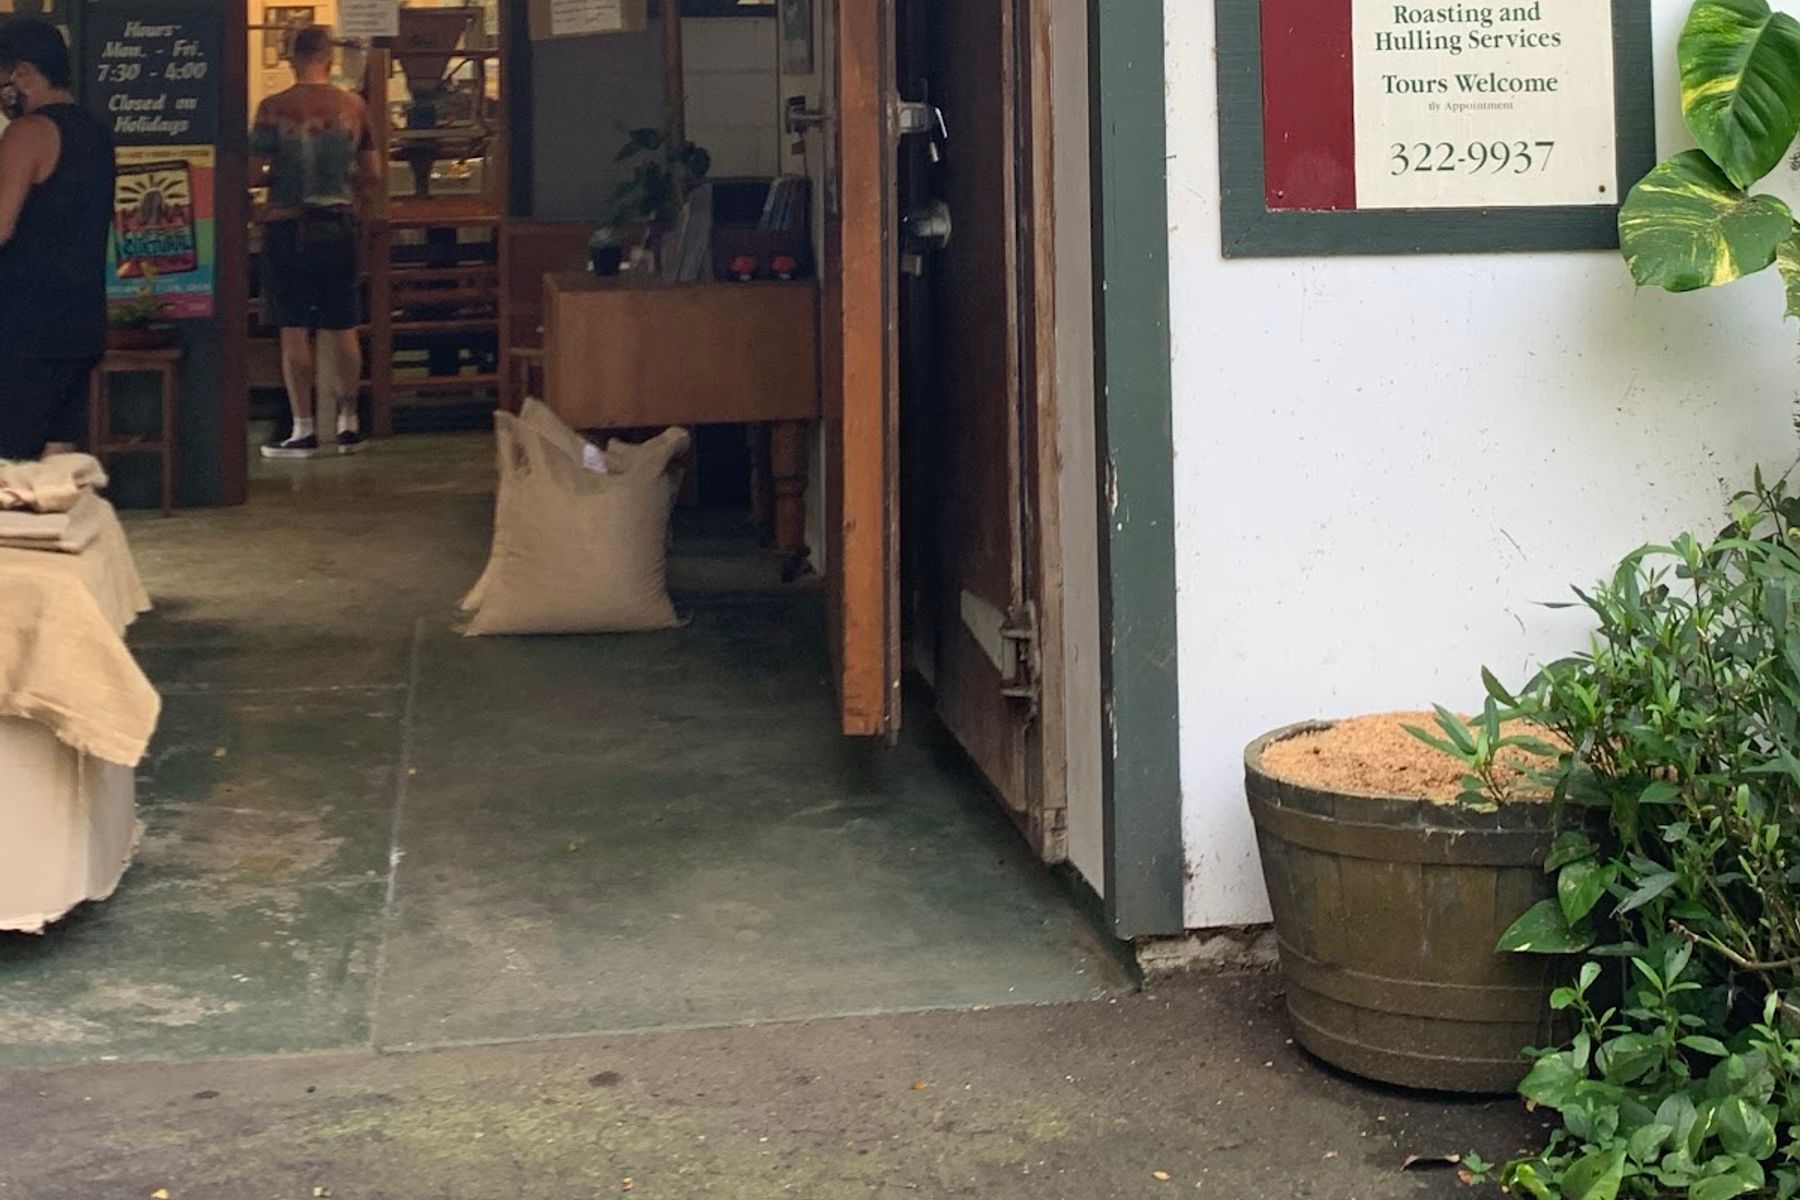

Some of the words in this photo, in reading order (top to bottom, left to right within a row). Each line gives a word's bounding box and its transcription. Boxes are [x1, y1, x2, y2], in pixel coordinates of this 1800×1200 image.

[1393, 4, 1493, 27] Roasting
[1499, 1, 1541, 22] and
[124, 21, 182, 37] Hours
[1374, 31, 1462, 55] Hulling
[1468, 29, 1561, 50] Services
[97, 63, 141, 82] 7:30
[1382, 74, 1448, 94] Tours
[1455, 72, 1558, 93] Welcome
[108, 94, 167, 111] Closed
[1444, 102, 1513, 113] Appointment
[114, 115, 190, 137] Holidays
[1390, 141, 1554, 176] 322-9937
